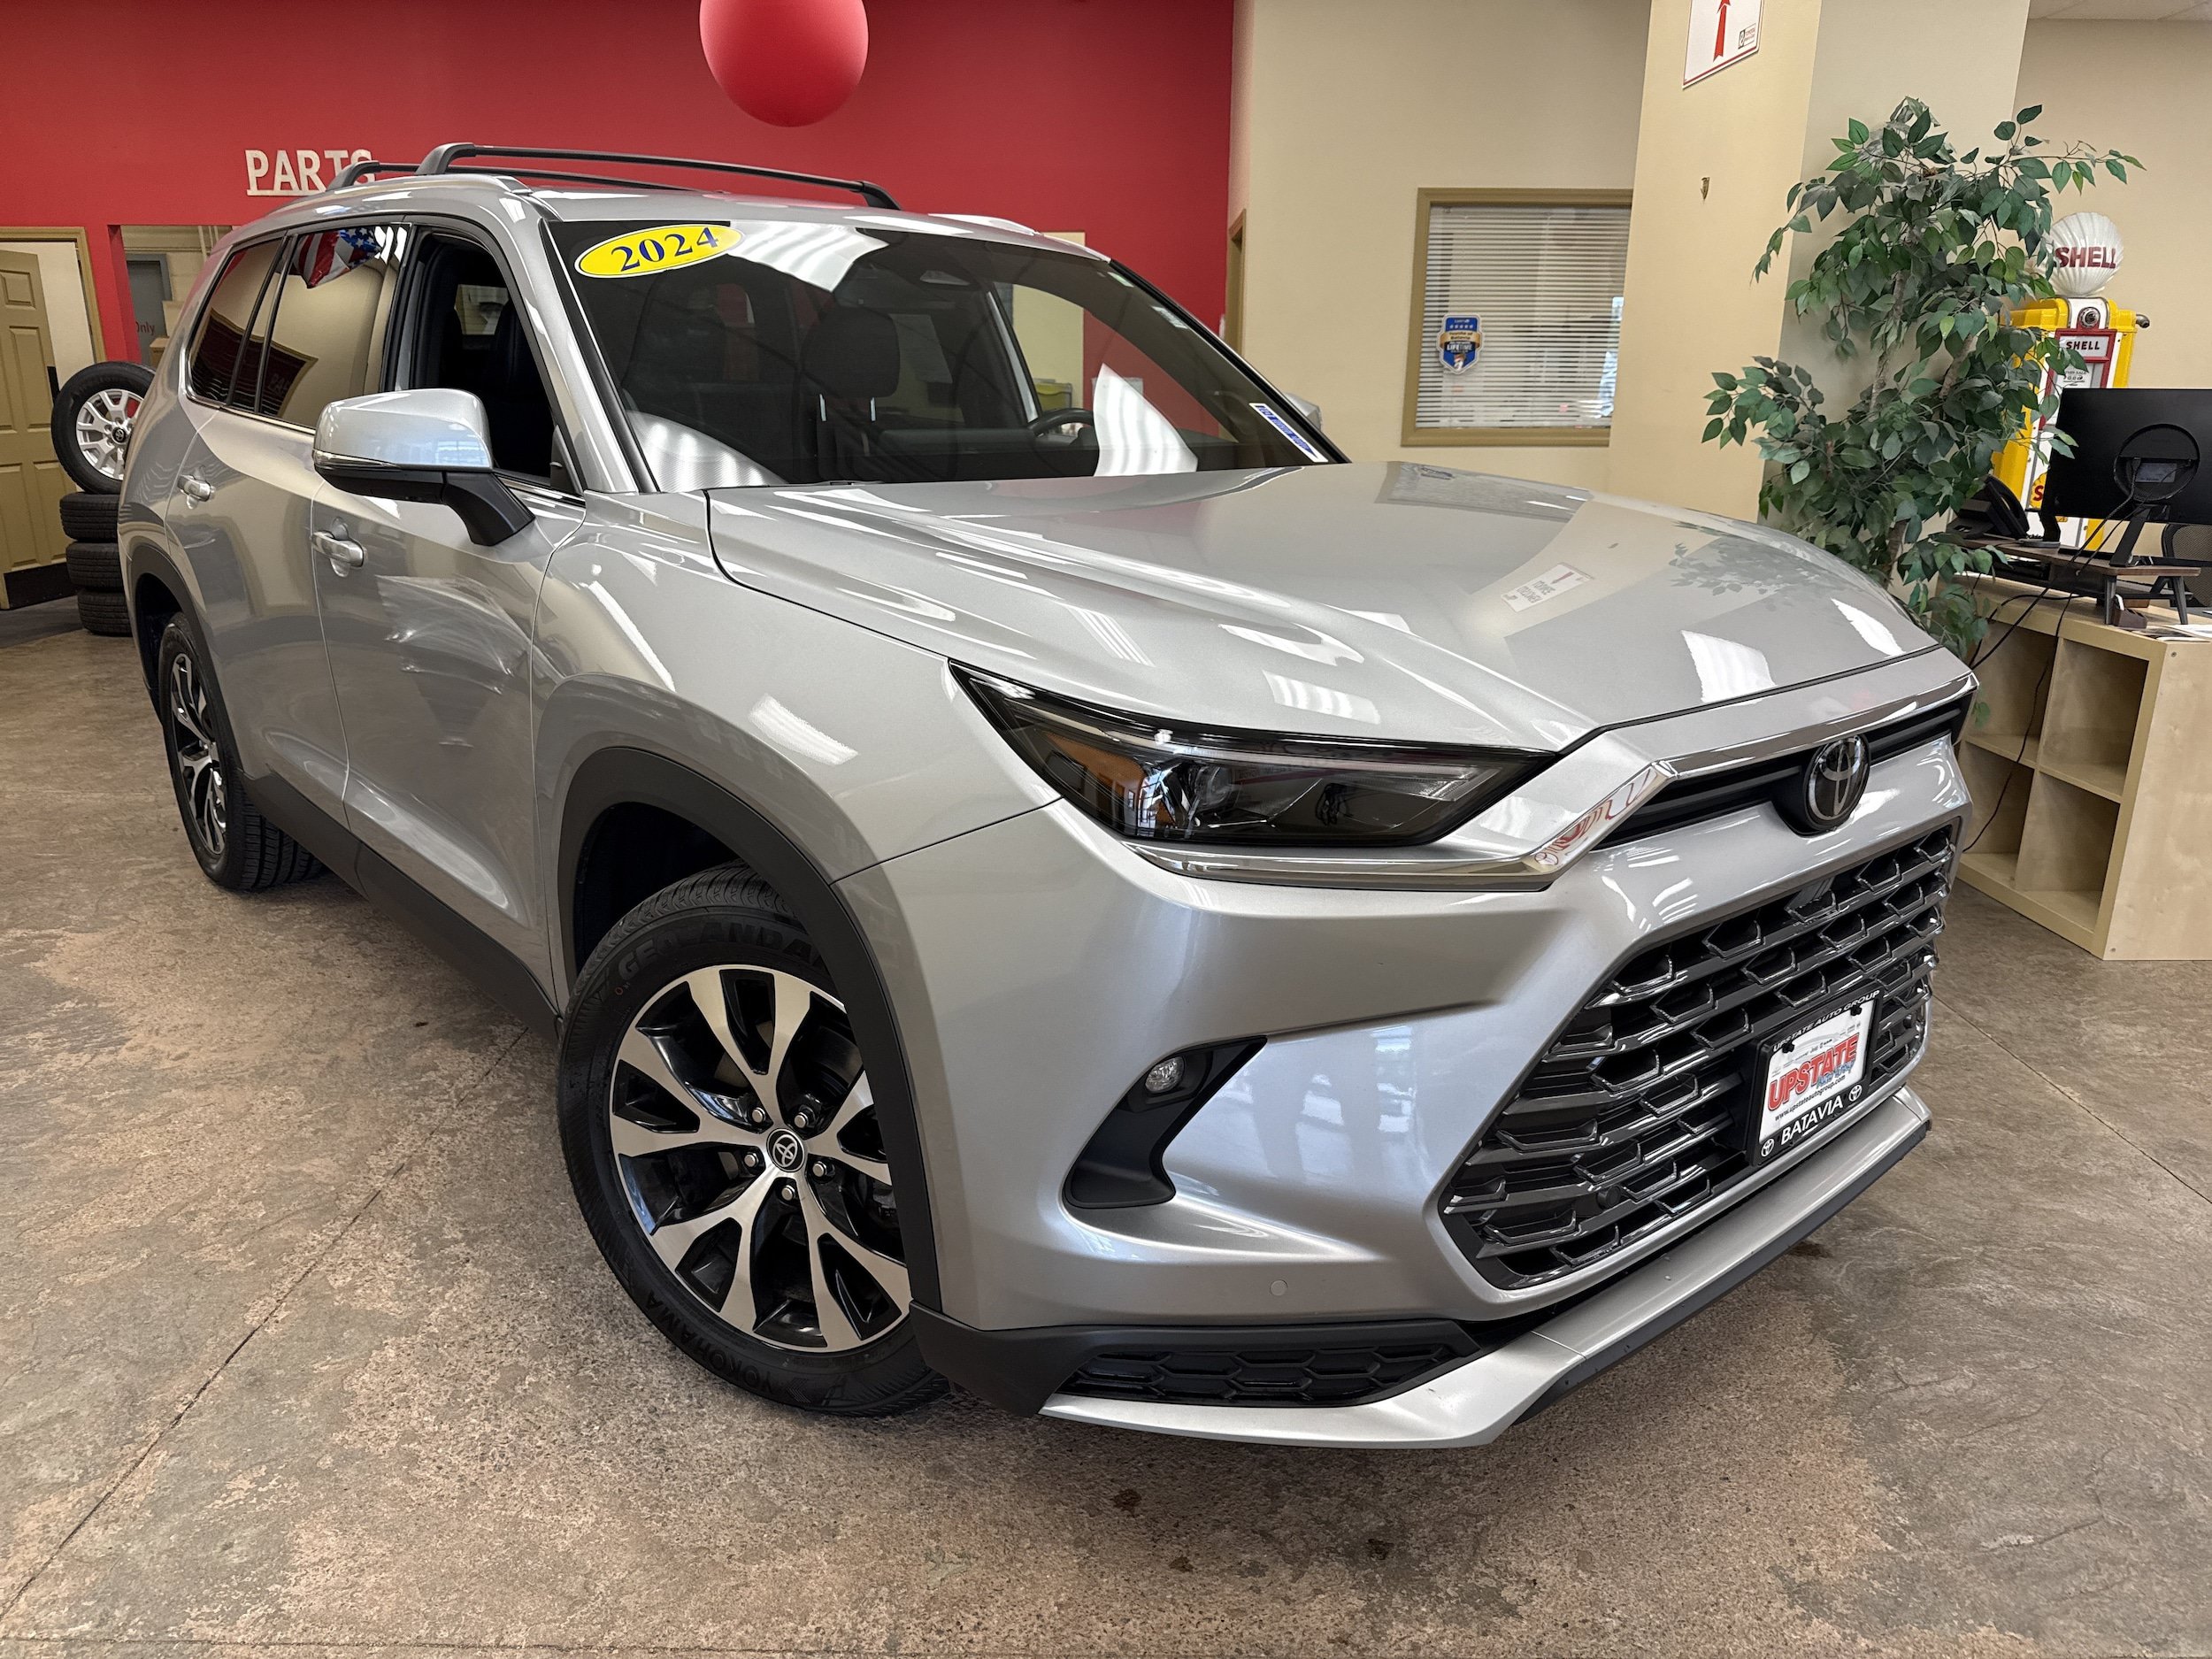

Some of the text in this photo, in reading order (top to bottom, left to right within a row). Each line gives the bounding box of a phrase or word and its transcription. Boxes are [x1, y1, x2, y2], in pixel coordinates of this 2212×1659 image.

[245, 149, 376, 191] PARTS
[611, 227, 718, 272] 2024
[2053, 246, 2116, 269] SHELL
[2066, 341, 2101, 350] SHELL
[618, 922, 825, 981] GEOLANDA
[1772, 990, 1880, 1052] UPSTATE AUTO GROUP
[1768, 1032, 1860, 1111] UPSTATE
[1775, 1074, 1846, 1122] www.upstateautogroup.com
[1781, 1095, 1844, 1145] BATAVIA
